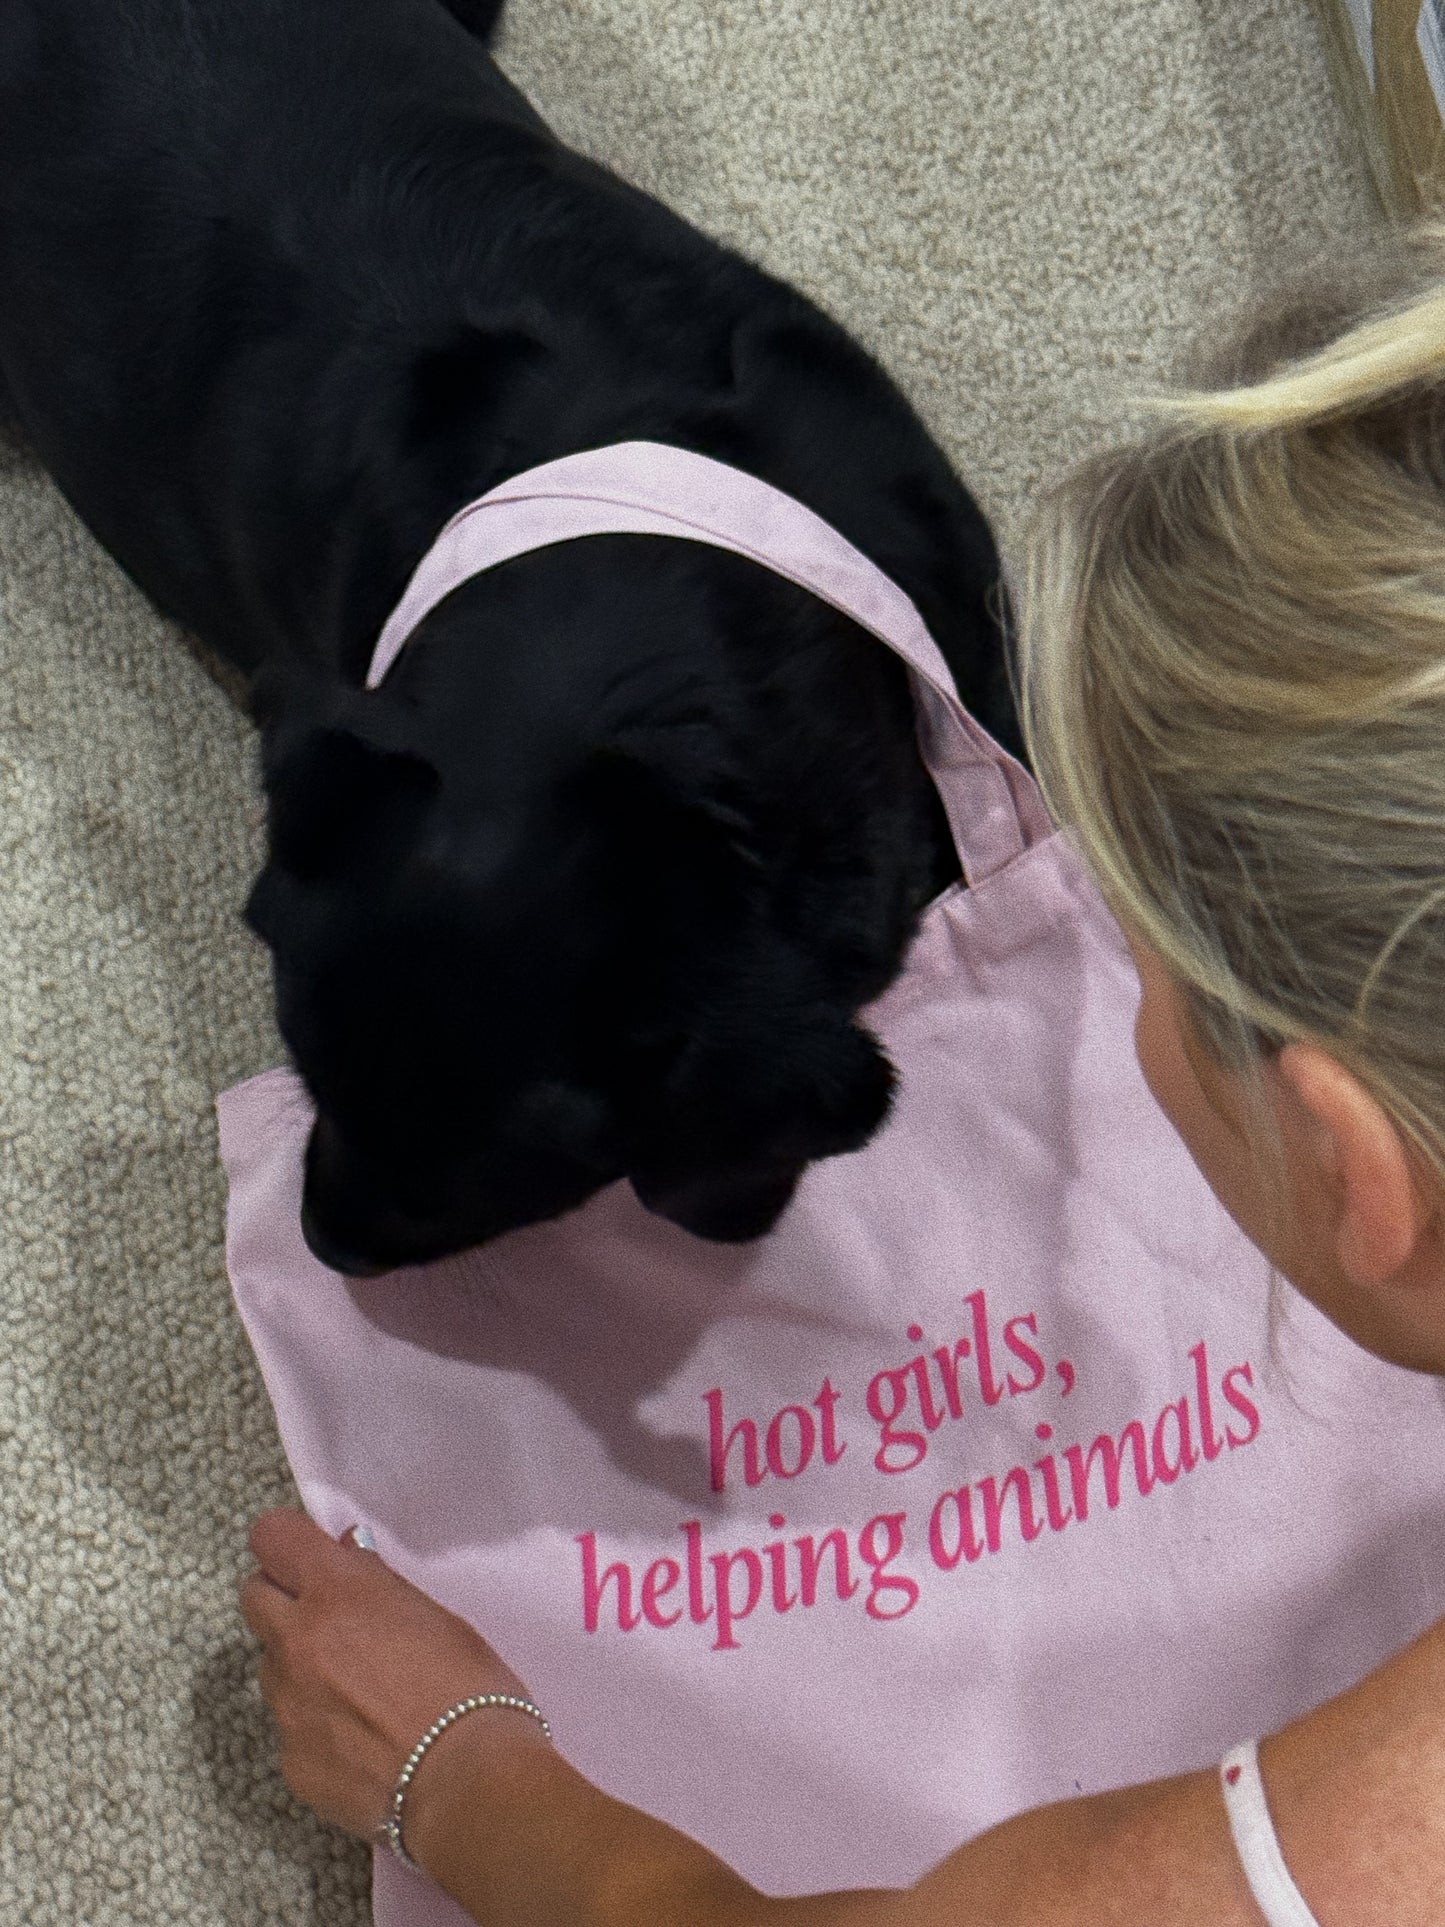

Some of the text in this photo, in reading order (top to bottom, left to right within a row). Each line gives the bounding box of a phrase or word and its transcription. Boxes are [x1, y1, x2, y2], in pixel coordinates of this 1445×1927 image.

[574, 1341, 1261, 1650] helping animals
[703, 1290, 1075, 1493] hot girls,
